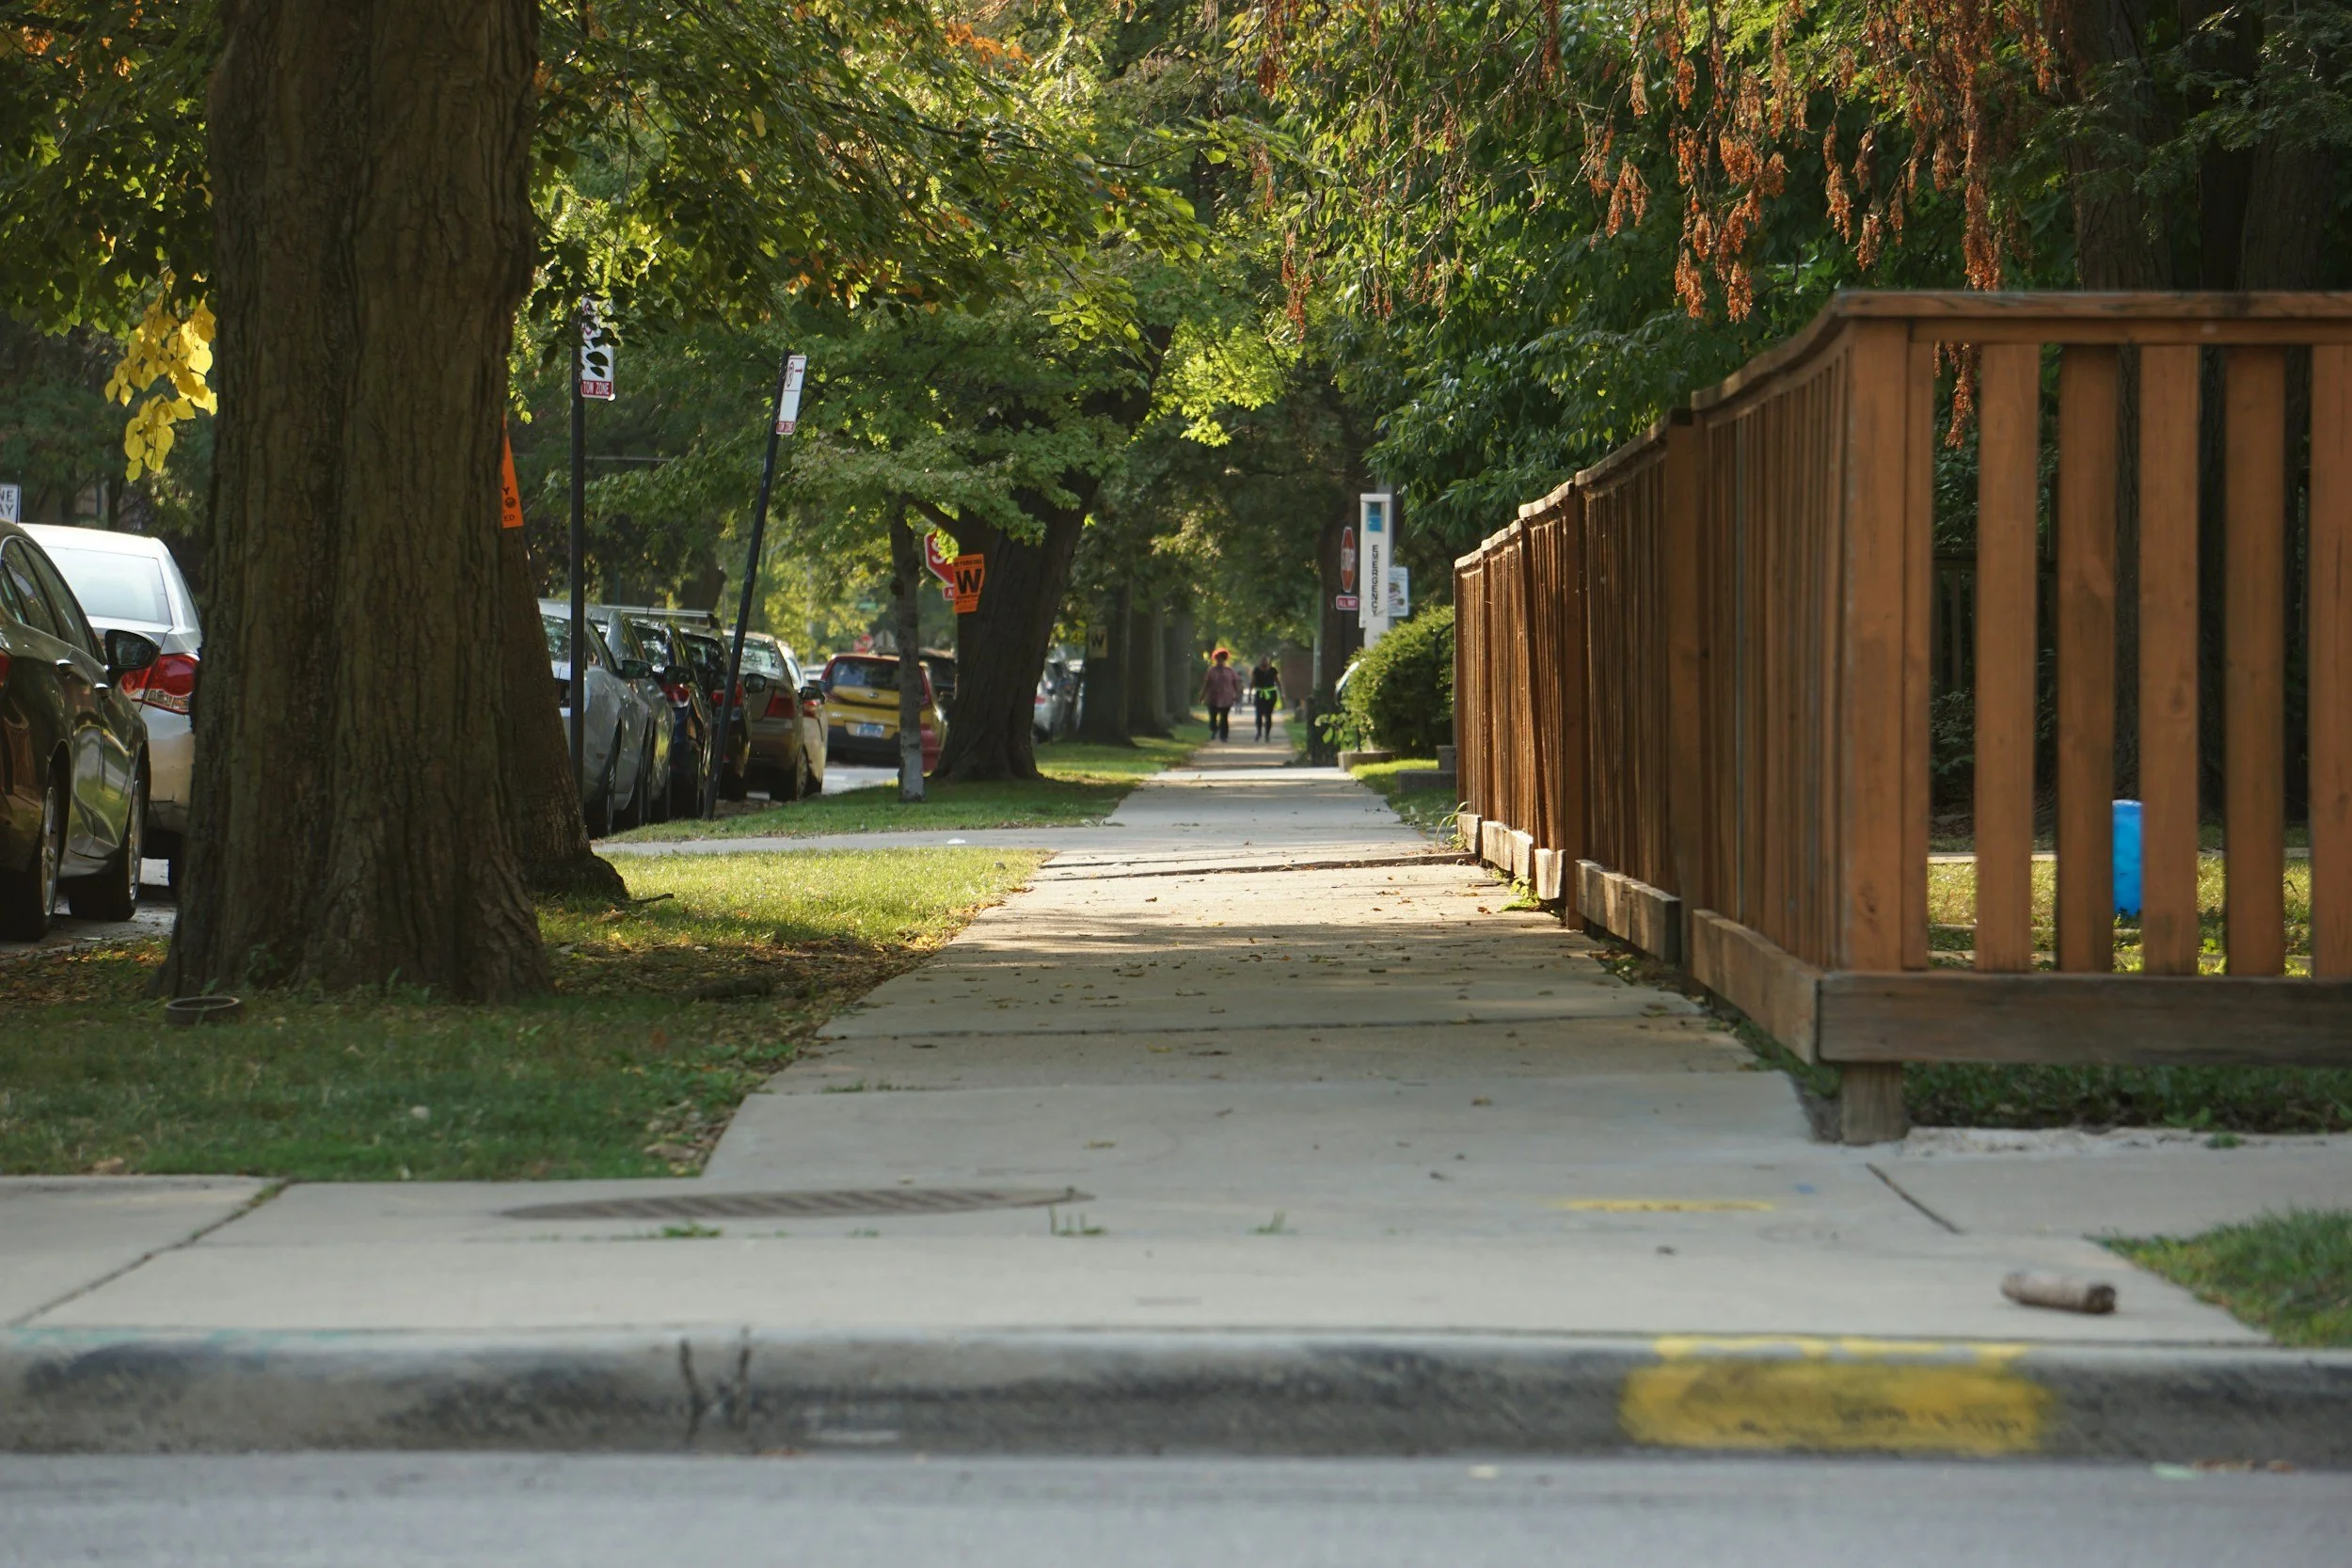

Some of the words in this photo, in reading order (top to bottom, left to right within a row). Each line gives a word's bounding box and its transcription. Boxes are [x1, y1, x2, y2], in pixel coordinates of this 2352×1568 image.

[583, 381, 594, 393] TOW
[596, 382, 610, 395] ZONE
[0, 489, 14, 502] NE
[955, 568, 982, 594] W
[1371, 544, 1379, 617] EMERGENCY
